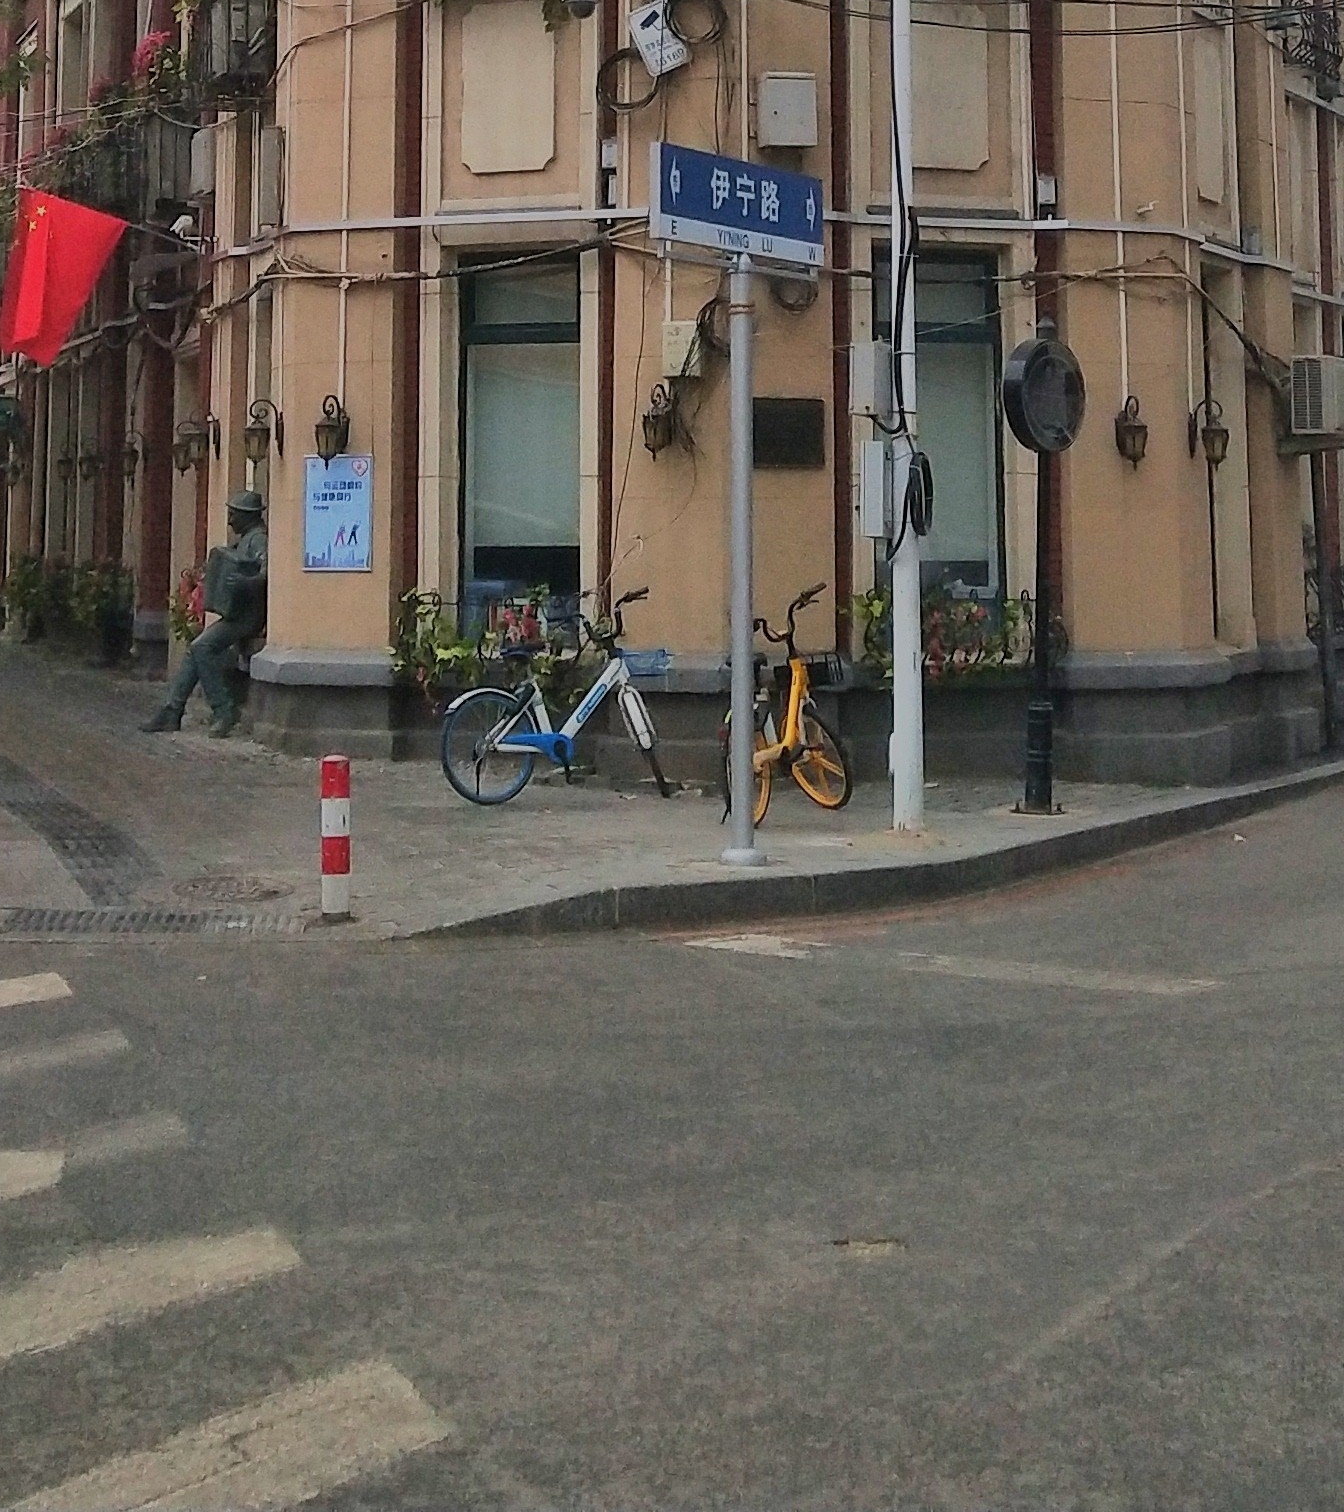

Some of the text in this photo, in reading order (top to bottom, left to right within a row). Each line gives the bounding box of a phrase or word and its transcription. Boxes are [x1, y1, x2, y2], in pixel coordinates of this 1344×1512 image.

[710, 167, 780, 223] 伊宁路
[671, 219, 678, 236] E
[762, 238, 773, 253] LU
[809, 247, 816, 261] W
